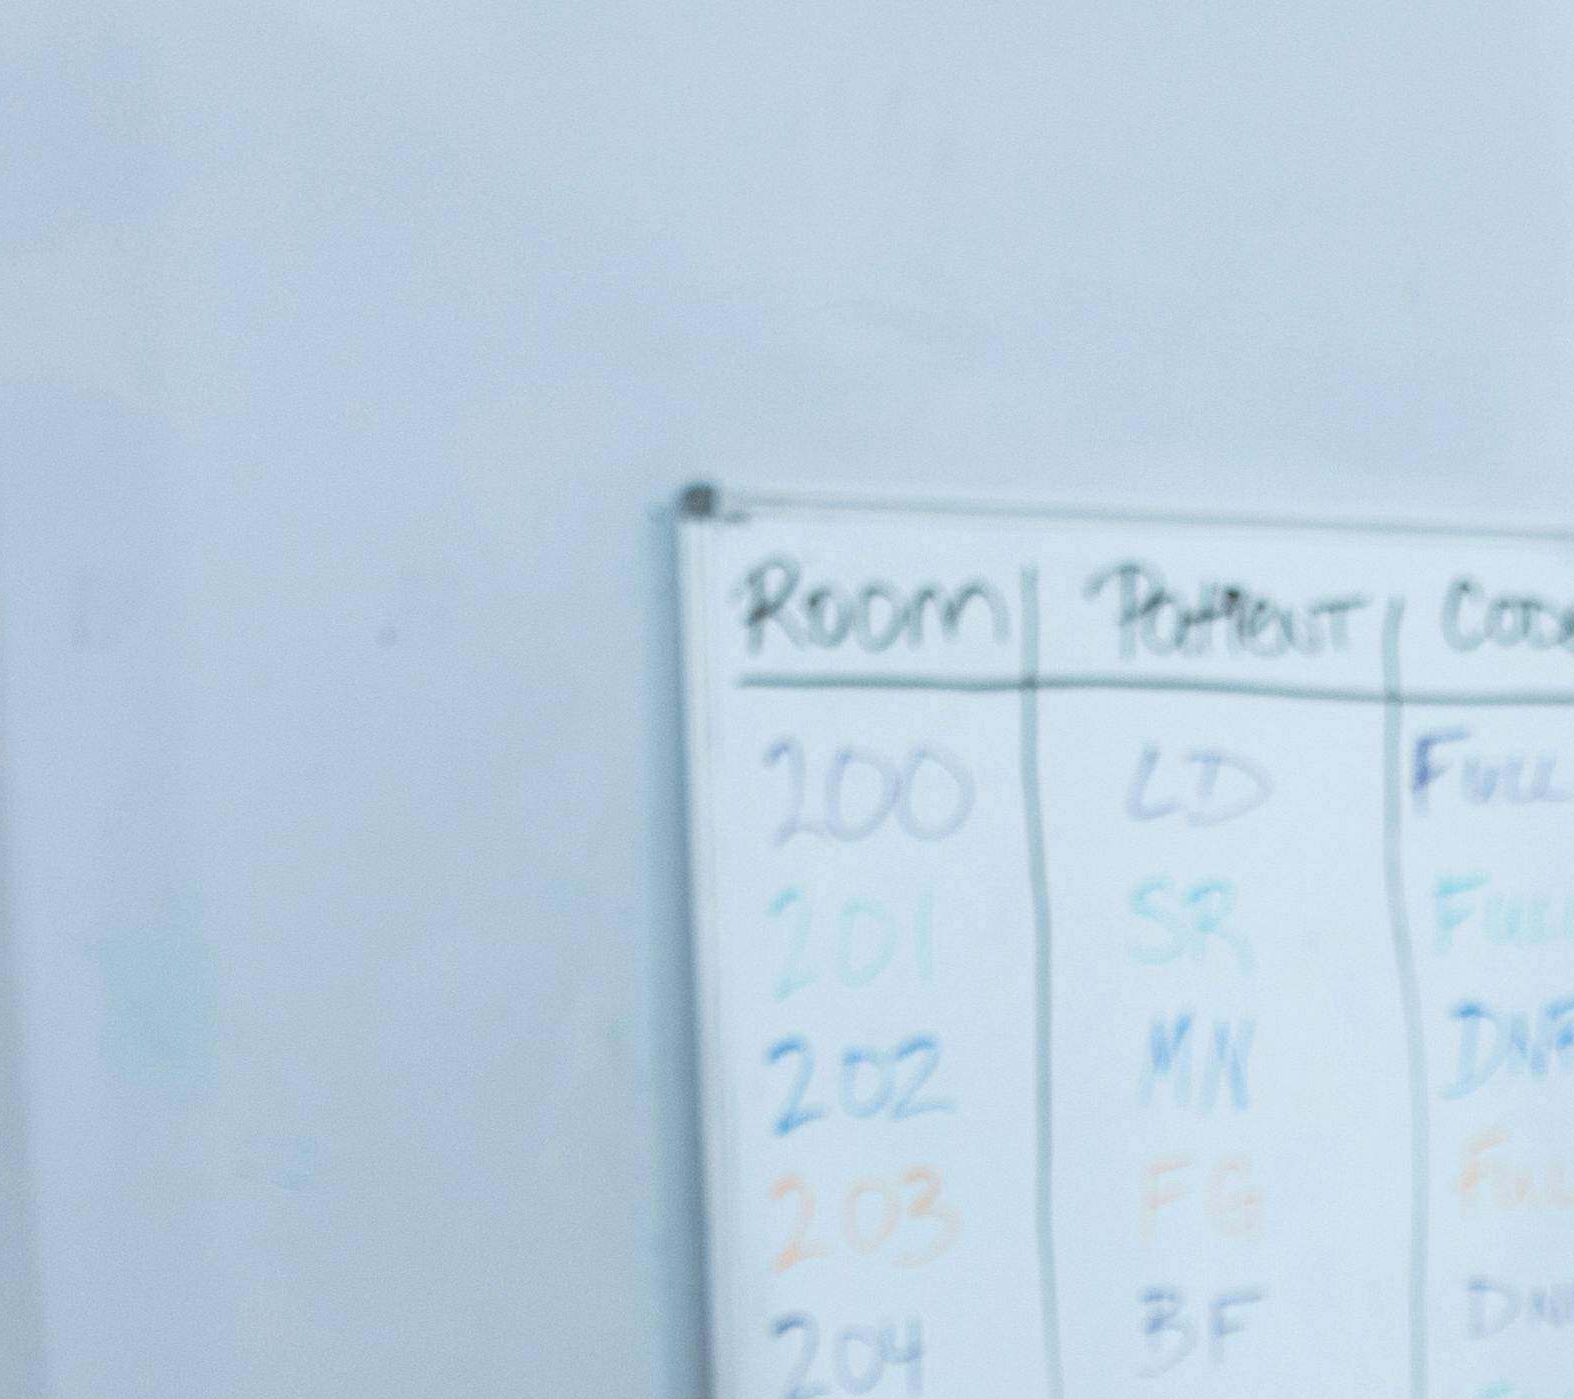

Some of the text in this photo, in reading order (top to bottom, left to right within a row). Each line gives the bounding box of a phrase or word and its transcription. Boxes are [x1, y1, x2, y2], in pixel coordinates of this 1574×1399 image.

[761, 734, 977, 850] 200
[1124, 741, 1277, 827] LD
[765, 883, 936, 1002] 201
[1124, 872, 1256, 974] SR
[763, 1031, 958, 1137] 202
[1135, 1009, 1257, 1117] MN
[767, 1162, 964, 1275] 203
[1132, 1284, 1269, 1381] BF
